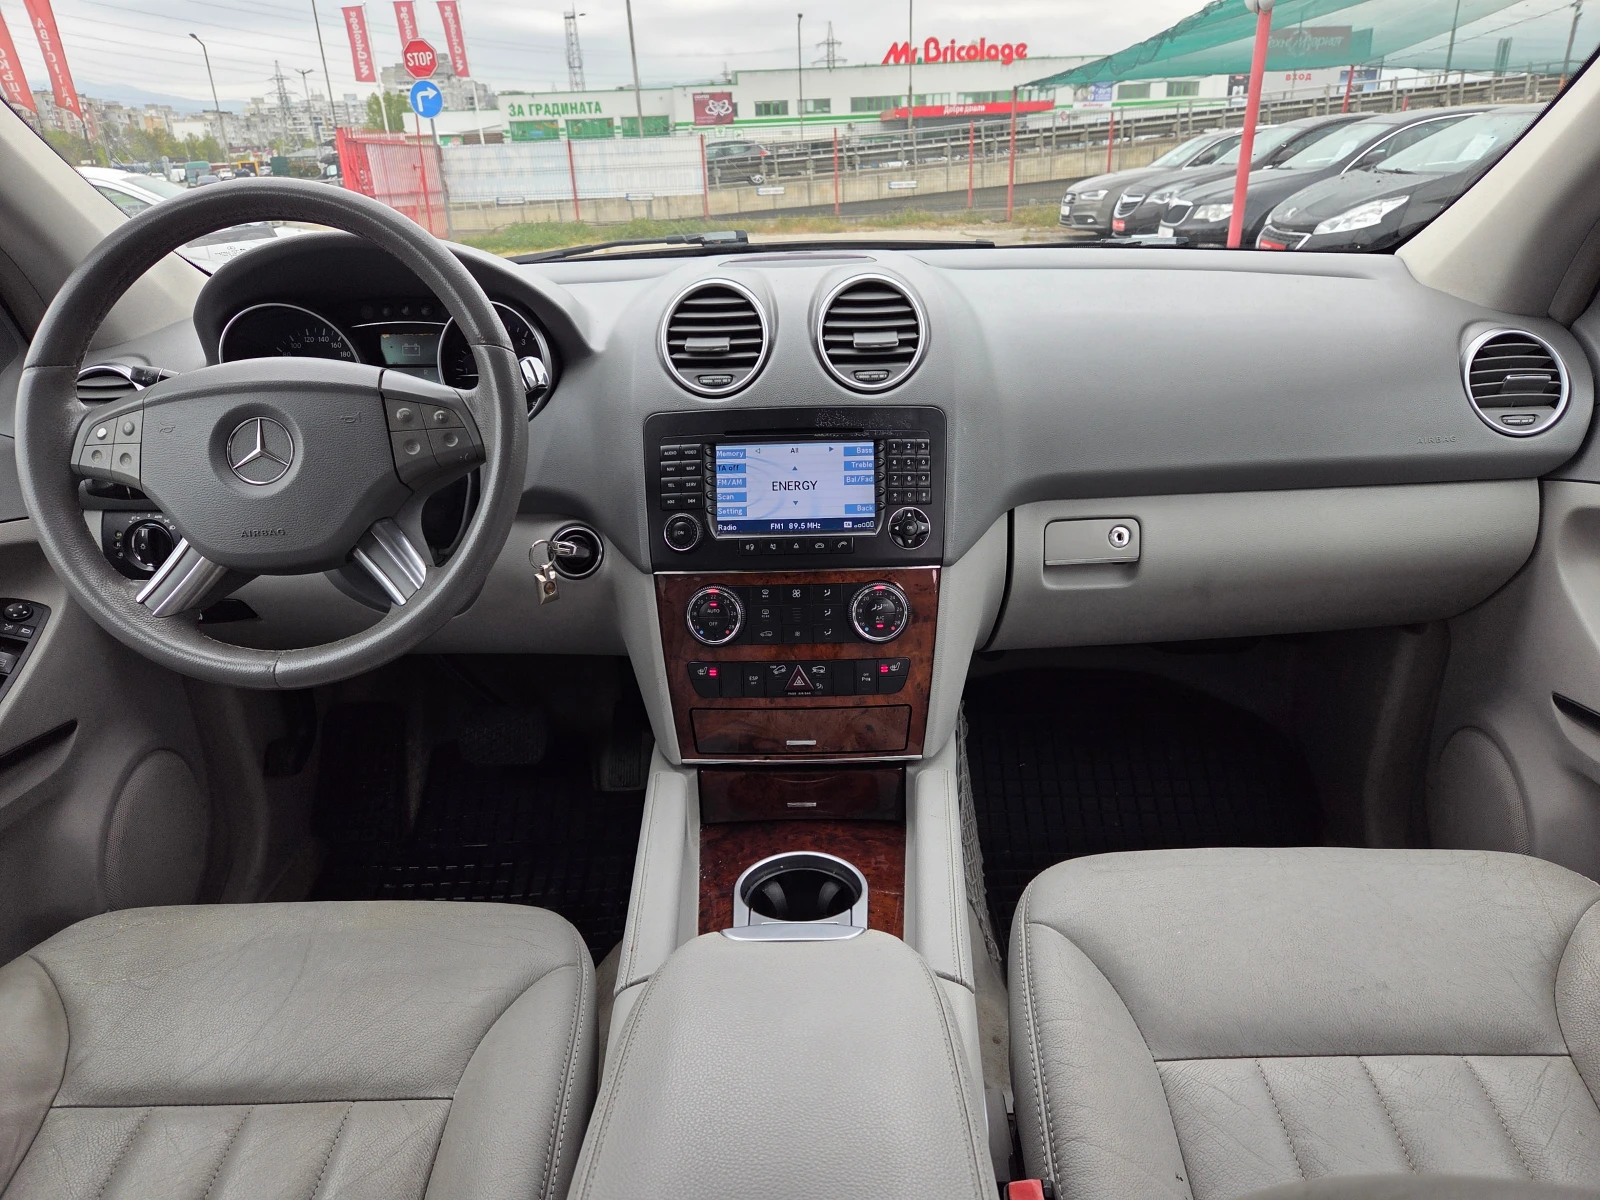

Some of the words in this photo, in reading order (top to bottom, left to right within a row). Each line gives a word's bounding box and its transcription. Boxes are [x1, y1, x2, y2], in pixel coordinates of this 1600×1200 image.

[406, 52, 432, 66] STOP
[508, 102, 524, 116] ЗА
[528, 101, 602, 117] ГРАДИНАТА
[1417, 436, 1457, 444] AIRBAG
[772, 480, 817, 491] ENERGY
[241, 529, 286, 537] AIRBAG
